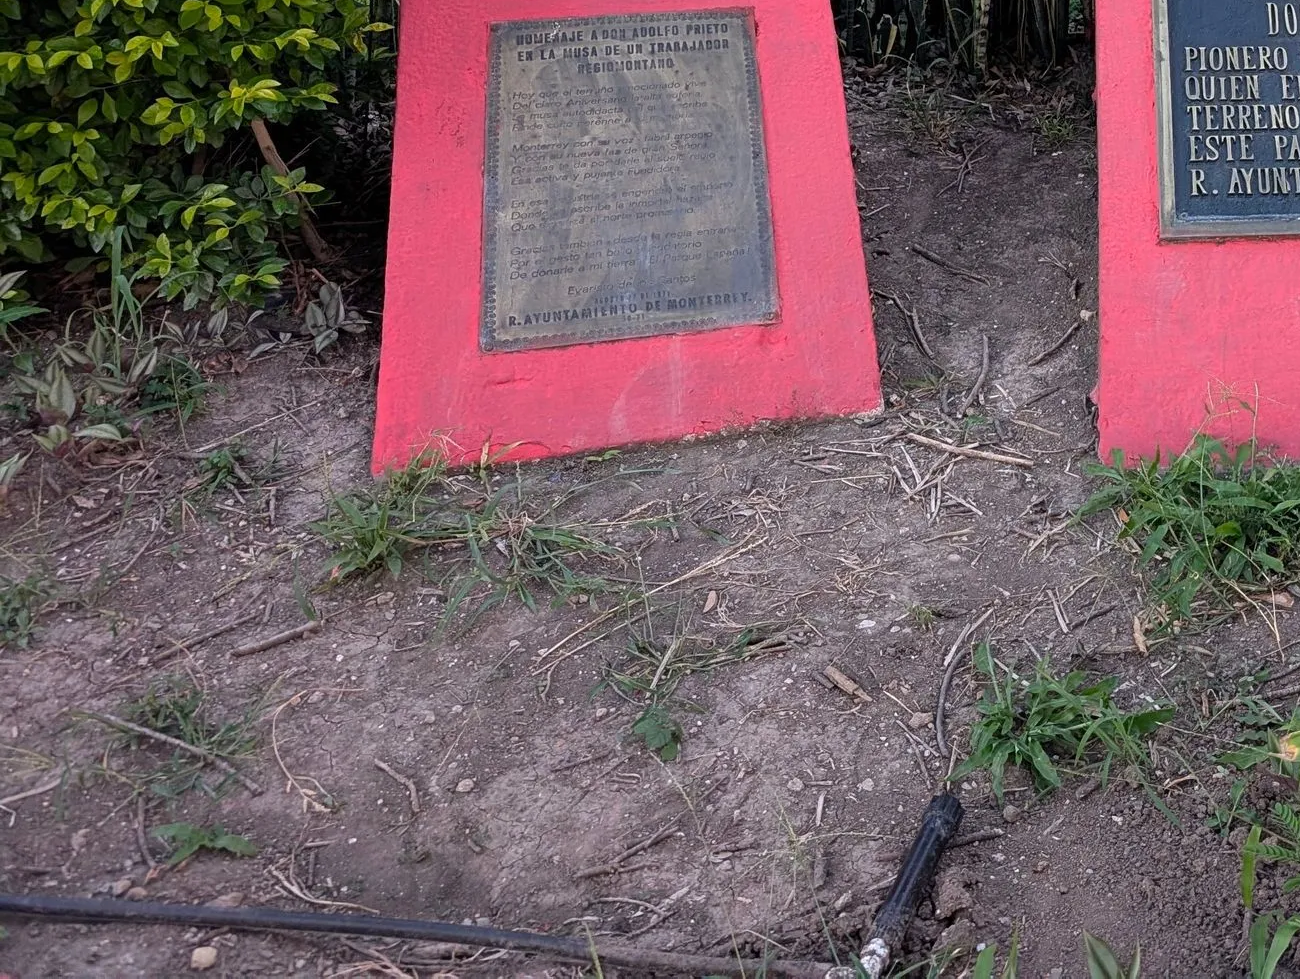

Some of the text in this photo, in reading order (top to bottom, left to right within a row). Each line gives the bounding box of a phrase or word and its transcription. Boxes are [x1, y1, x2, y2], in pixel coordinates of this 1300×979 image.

[516, 23, 728, 45] HOMENAJE A DON ADOLFO PRIETO
[518, 39, 729, 61] EN LA MUSA DE UN TRABAJADOR
[1185, 46, 1288, 71] PIONERO
[577, 58, 674, 74] REGIOMONTANO
[1185, 74, 1260, 102] QUIEN
[1187, 104, 1300, 130] TERRENO
[1189, 134, 1254, 161] ESTE
[1190, 169, 1219, 196] R.
[508, 316, 522, 327] R.
[524, 302, 637, 326] AYUNTAMIENTO
[646, 300, 661, 312] DE
